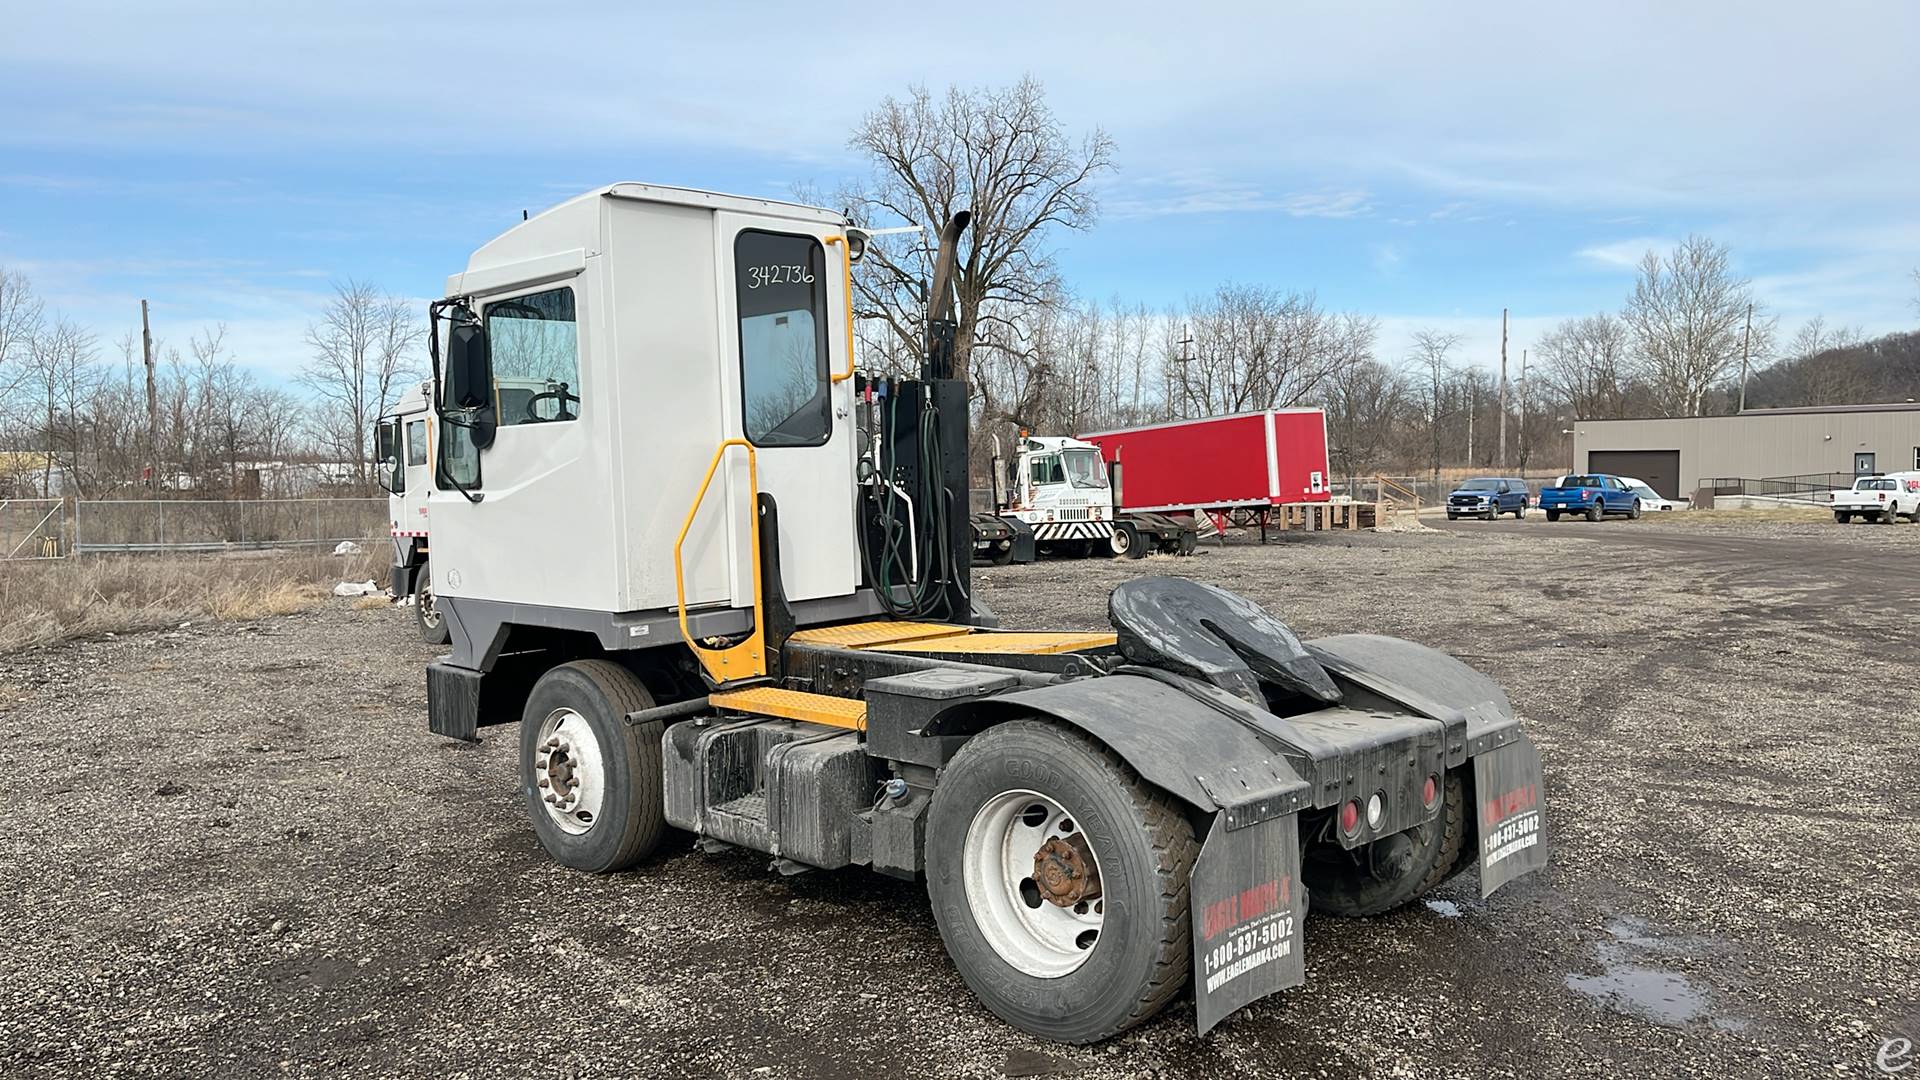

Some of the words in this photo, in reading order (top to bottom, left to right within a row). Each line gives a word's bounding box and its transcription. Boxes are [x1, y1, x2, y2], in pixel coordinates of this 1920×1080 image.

[748, 265, 815, 289] 342736
[1204, 917, 1293, 975] 1-800-837-5002
[1206, 940, 1291, 994] WWW.EAGLEMARK4.COM
